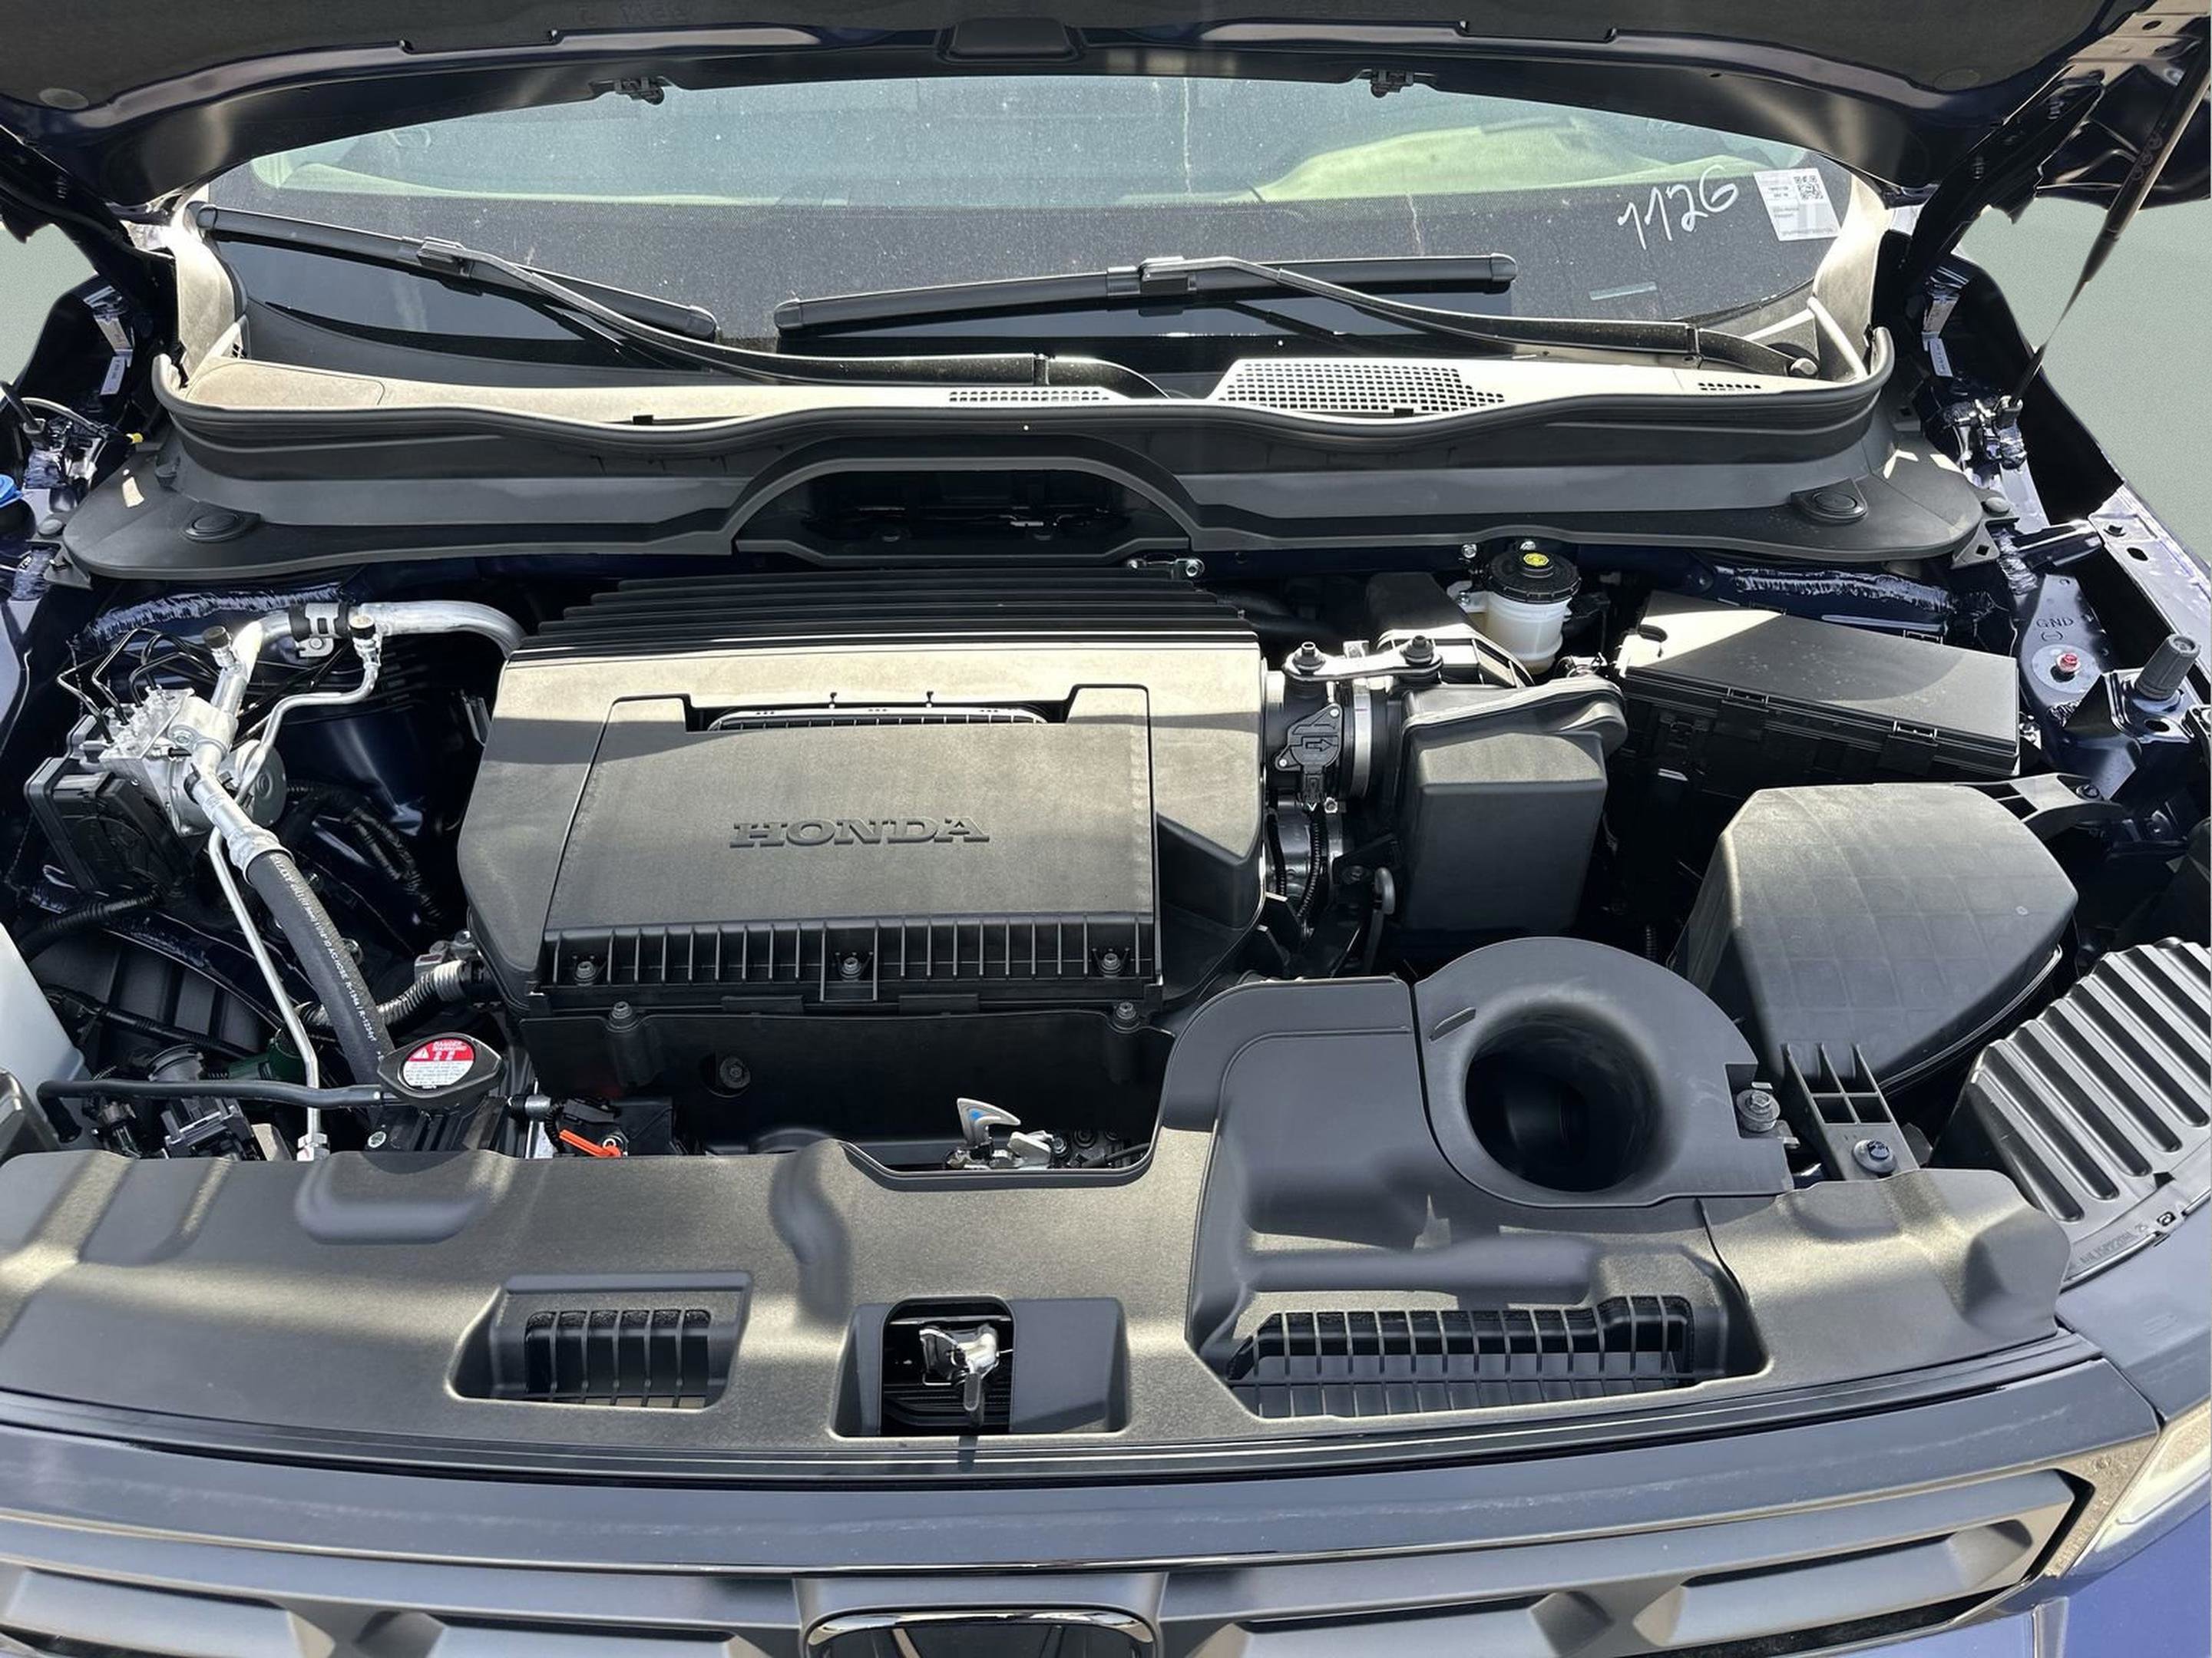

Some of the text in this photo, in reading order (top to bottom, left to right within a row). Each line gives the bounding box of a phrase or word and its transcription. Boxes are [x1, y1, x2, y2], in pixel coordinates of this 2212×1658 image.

[1617, 163, 1739, 250] 1126
[2036, 618, 2074, 628] GND
[729, 816, 990, 848] HONDA
